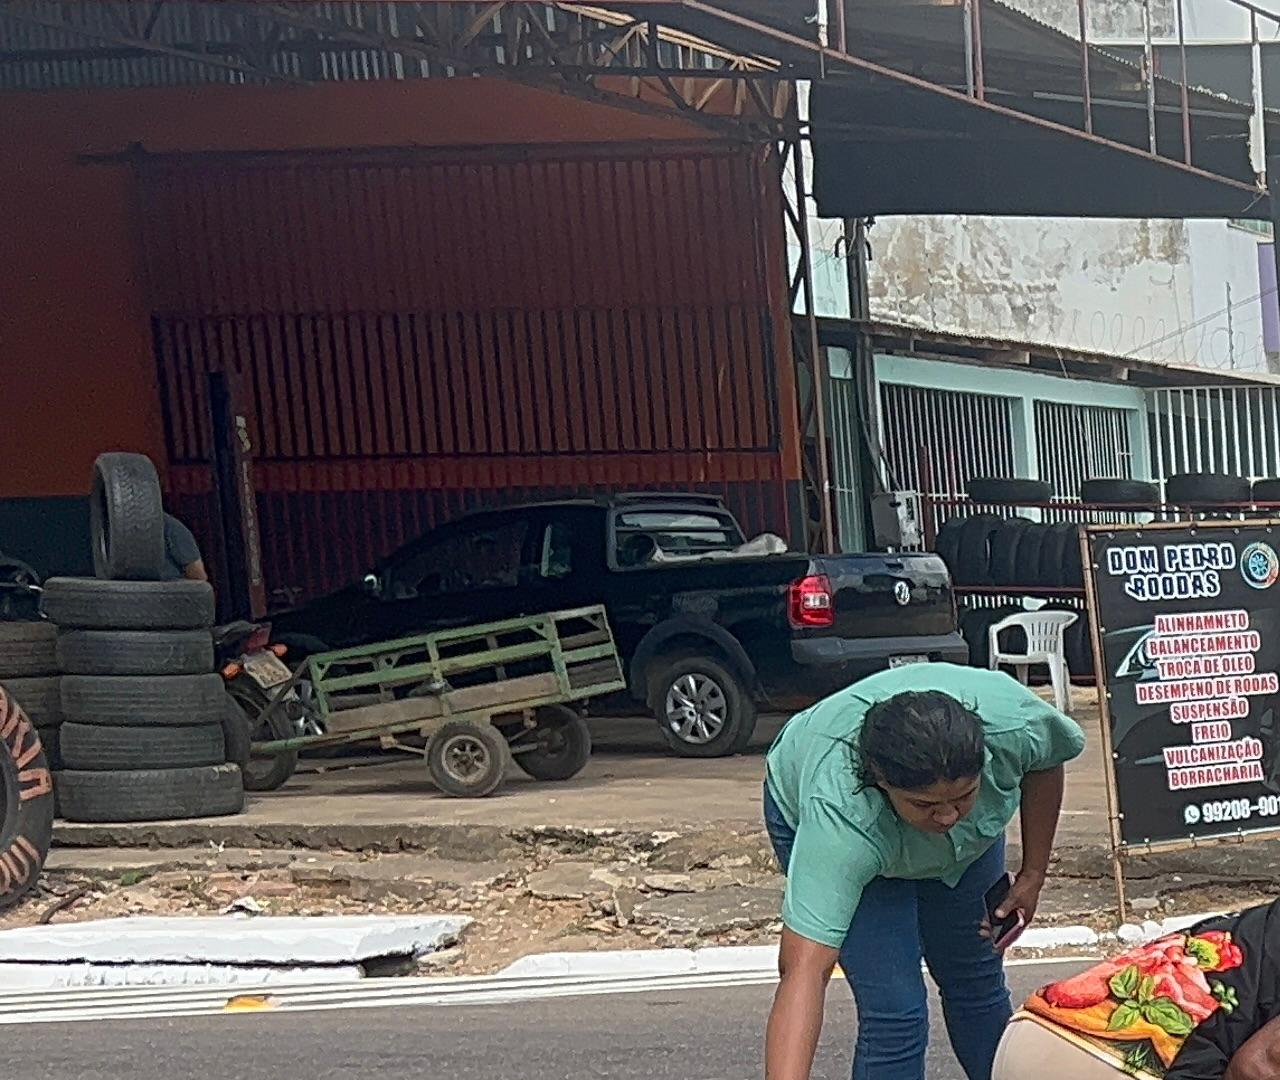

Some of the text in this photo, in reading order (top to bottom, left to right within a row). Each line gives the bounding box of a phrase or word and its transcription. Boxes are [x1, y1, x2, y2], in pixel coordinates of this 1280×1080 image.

[1108, 544, 1235, 574] DOM PEDRO
[1125, 571, 1220, 600] ROODAS
[1156, 612, 1247, 633] ALINHAMNETO
[1149, 633, 1259, 656] BALANCEAMENTO
[1159, 655, 1253, 678] TROCA DE OLEO
[1138, 675, 1277, 702] DESEMPENO DE RODAS
[1172, 697, 1247, 721] SUSPENSÃO
[1194, 723, 1229, 741] FREIO
[1165, 739, 1261, 766] VULCANIZAÇÃO
[1170, 764, 1261, 787] BORRACHARIA
